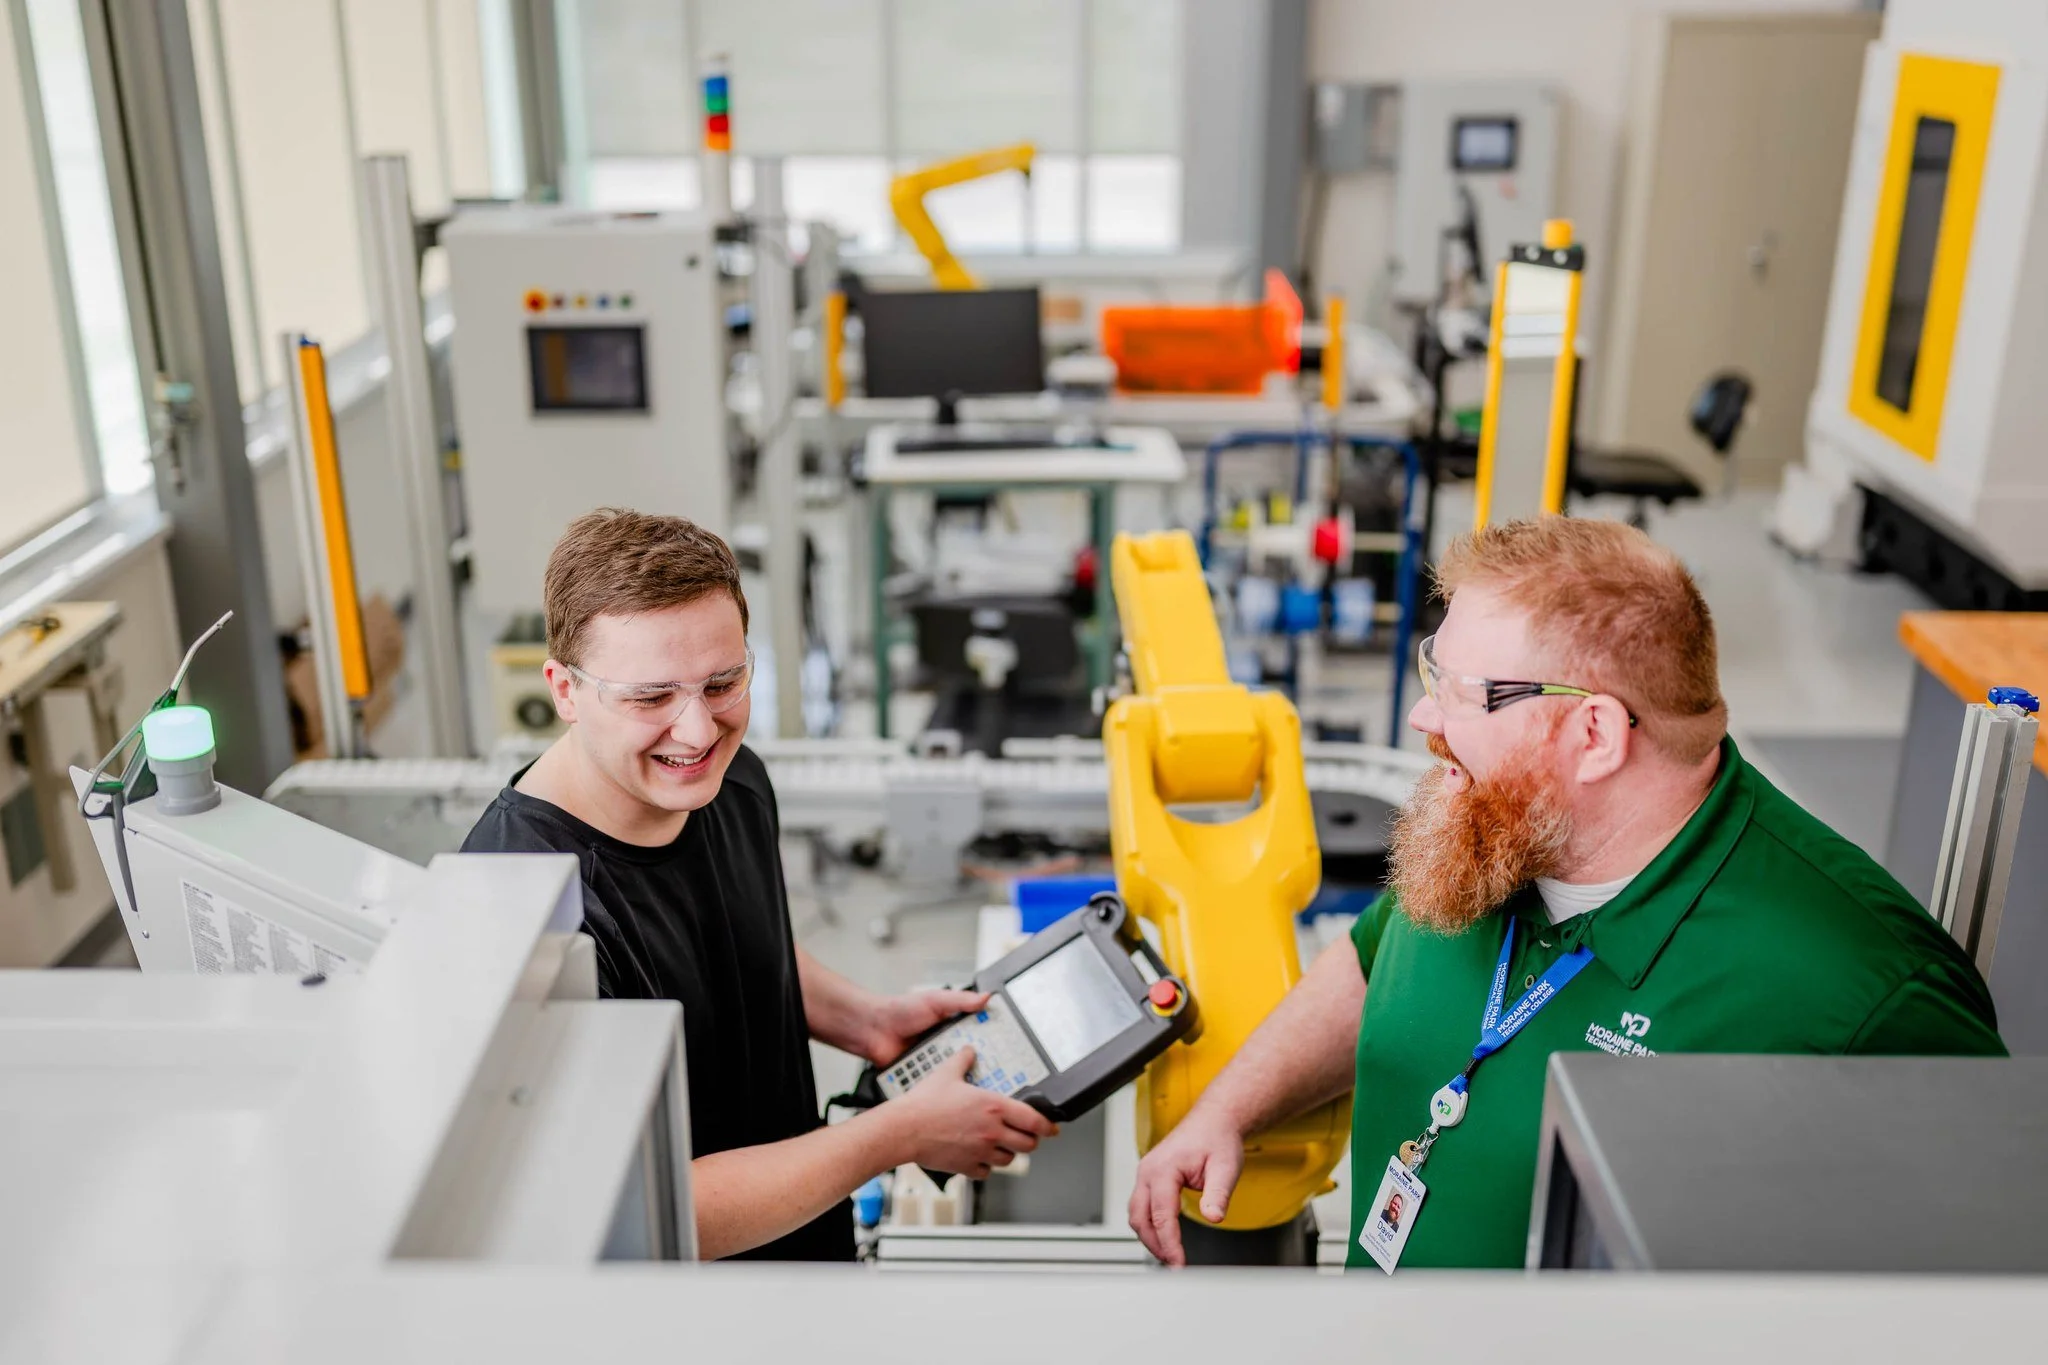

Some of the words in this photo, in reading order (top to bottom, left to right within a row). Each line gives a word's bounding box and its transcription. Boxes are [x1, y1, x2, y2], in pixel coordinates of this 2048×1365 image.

[1494, 962, 1508, 1005] MORAINE
[1487, 1006, 1499, 1030] PARK
[1497, 999, 1531, 1034] MORAINE
[1528, 979, 1551, 1003] PARK
[1501, 1011, 1532, 1038] TECHNICAL
[1530, 986, 1555, 1011] COLLEGE
[1587, 1022, 1634, 1052] MORAINE
[1388, 1165, 1409, 1190] MORAINE
[1407, 1185, 1421, 1200] PARK
[1377, 1221, 1394, 1242] David
